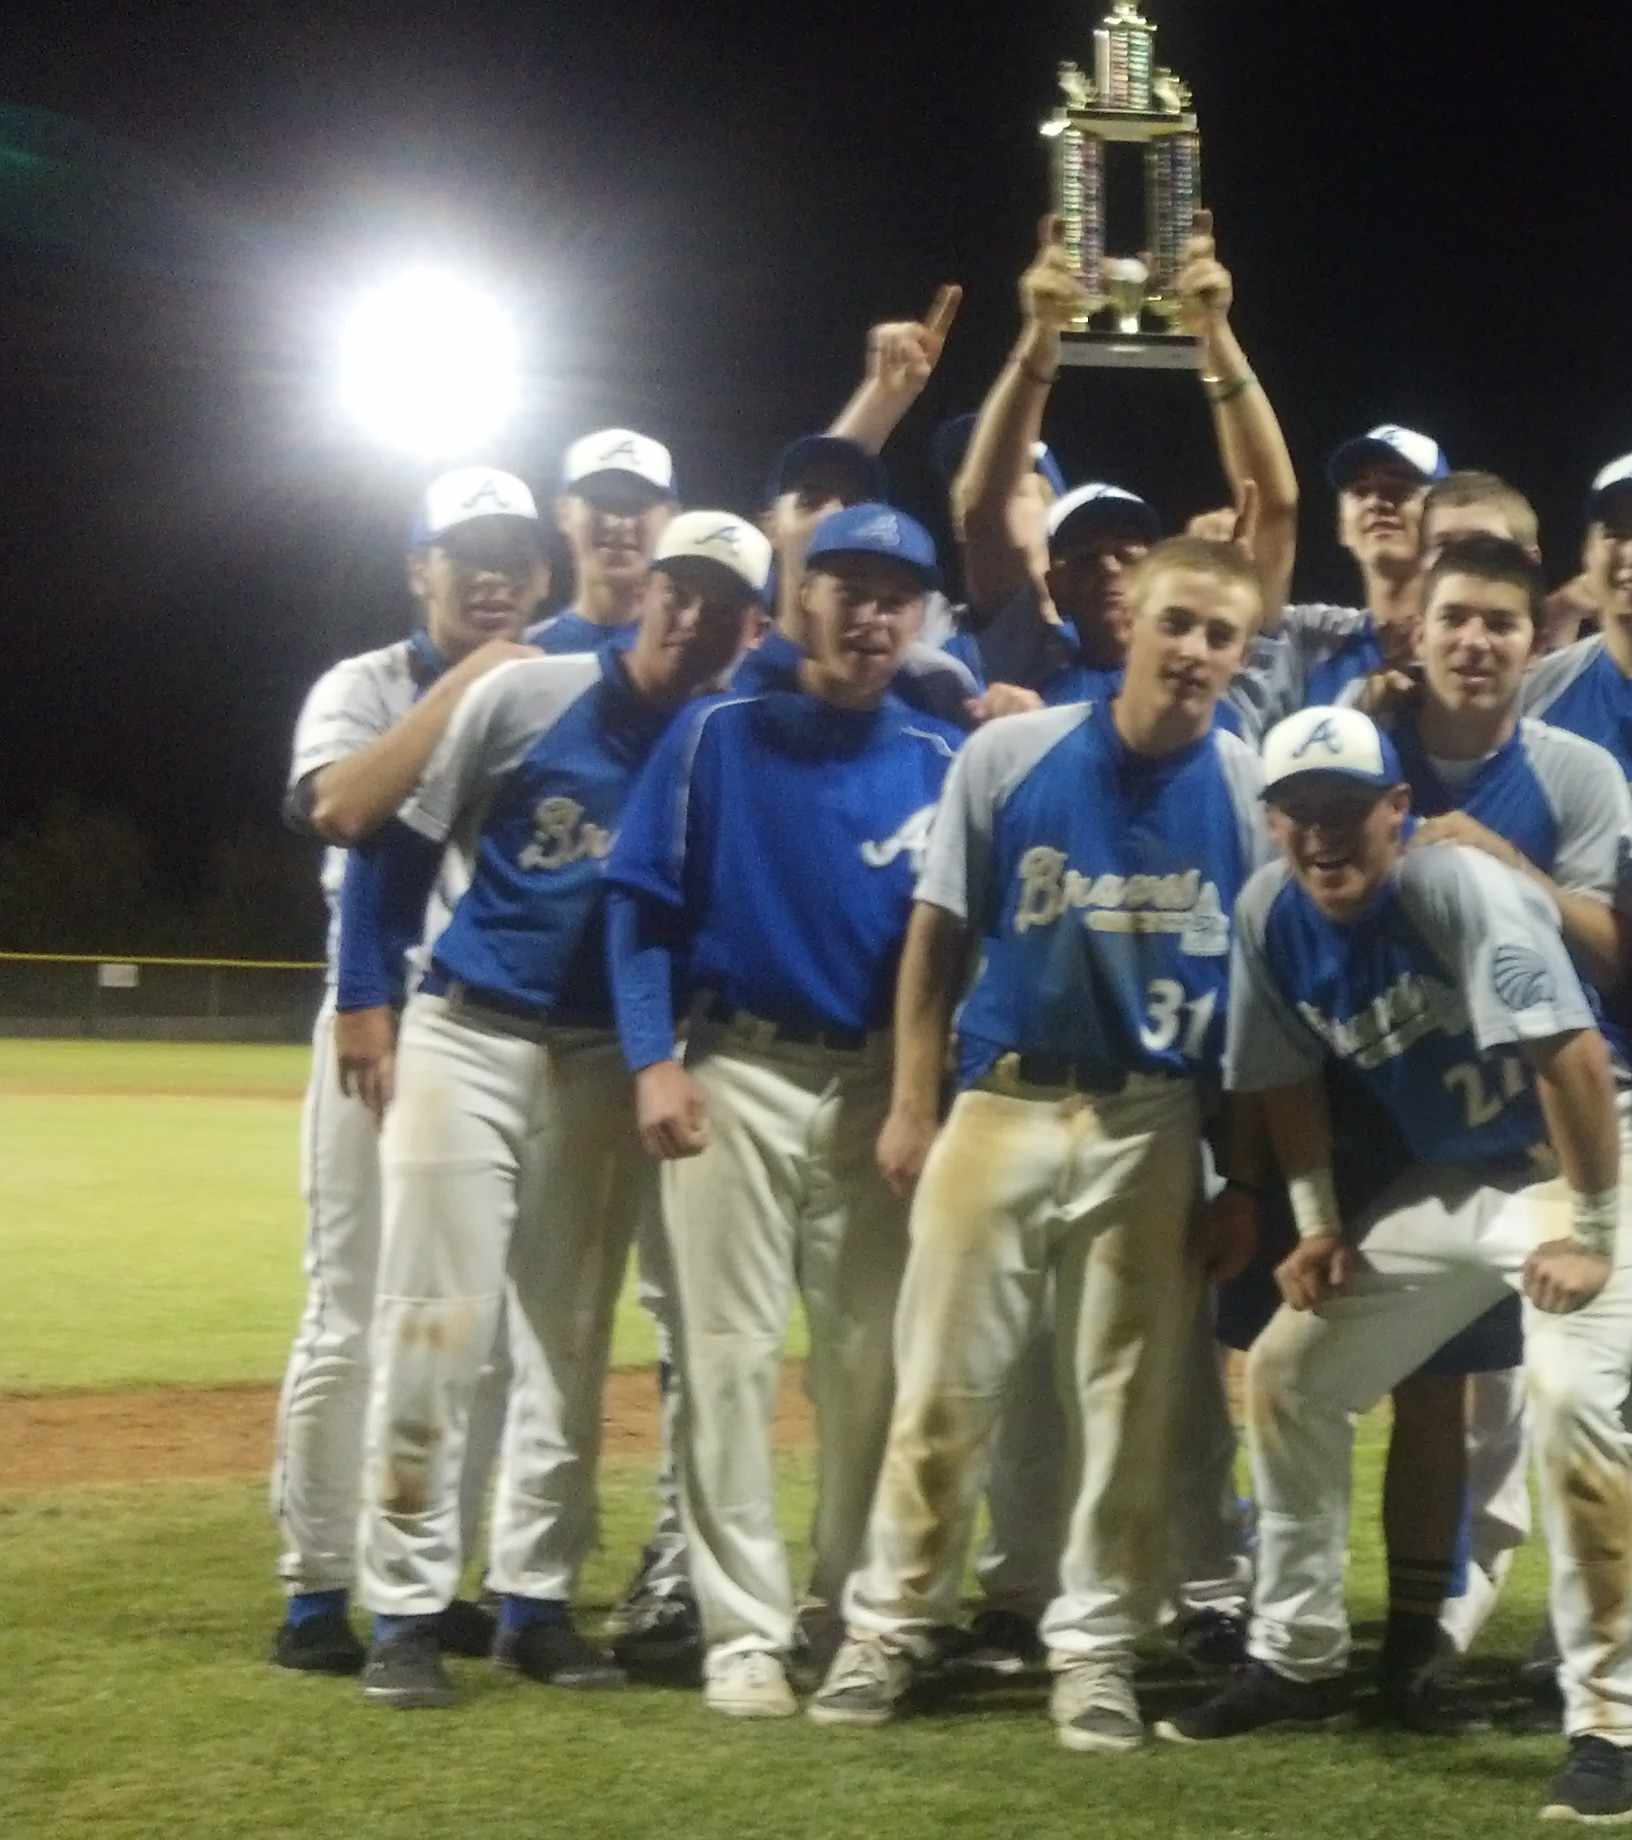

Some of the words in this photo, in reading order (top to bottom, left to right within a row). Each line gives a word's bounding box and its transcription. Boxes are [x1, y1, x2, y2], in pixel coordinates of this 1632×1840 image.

[461, 479, 512, 509] A
[1290, 717, 1340, 759] A
[1139, 977, 1218, 1059] 31
